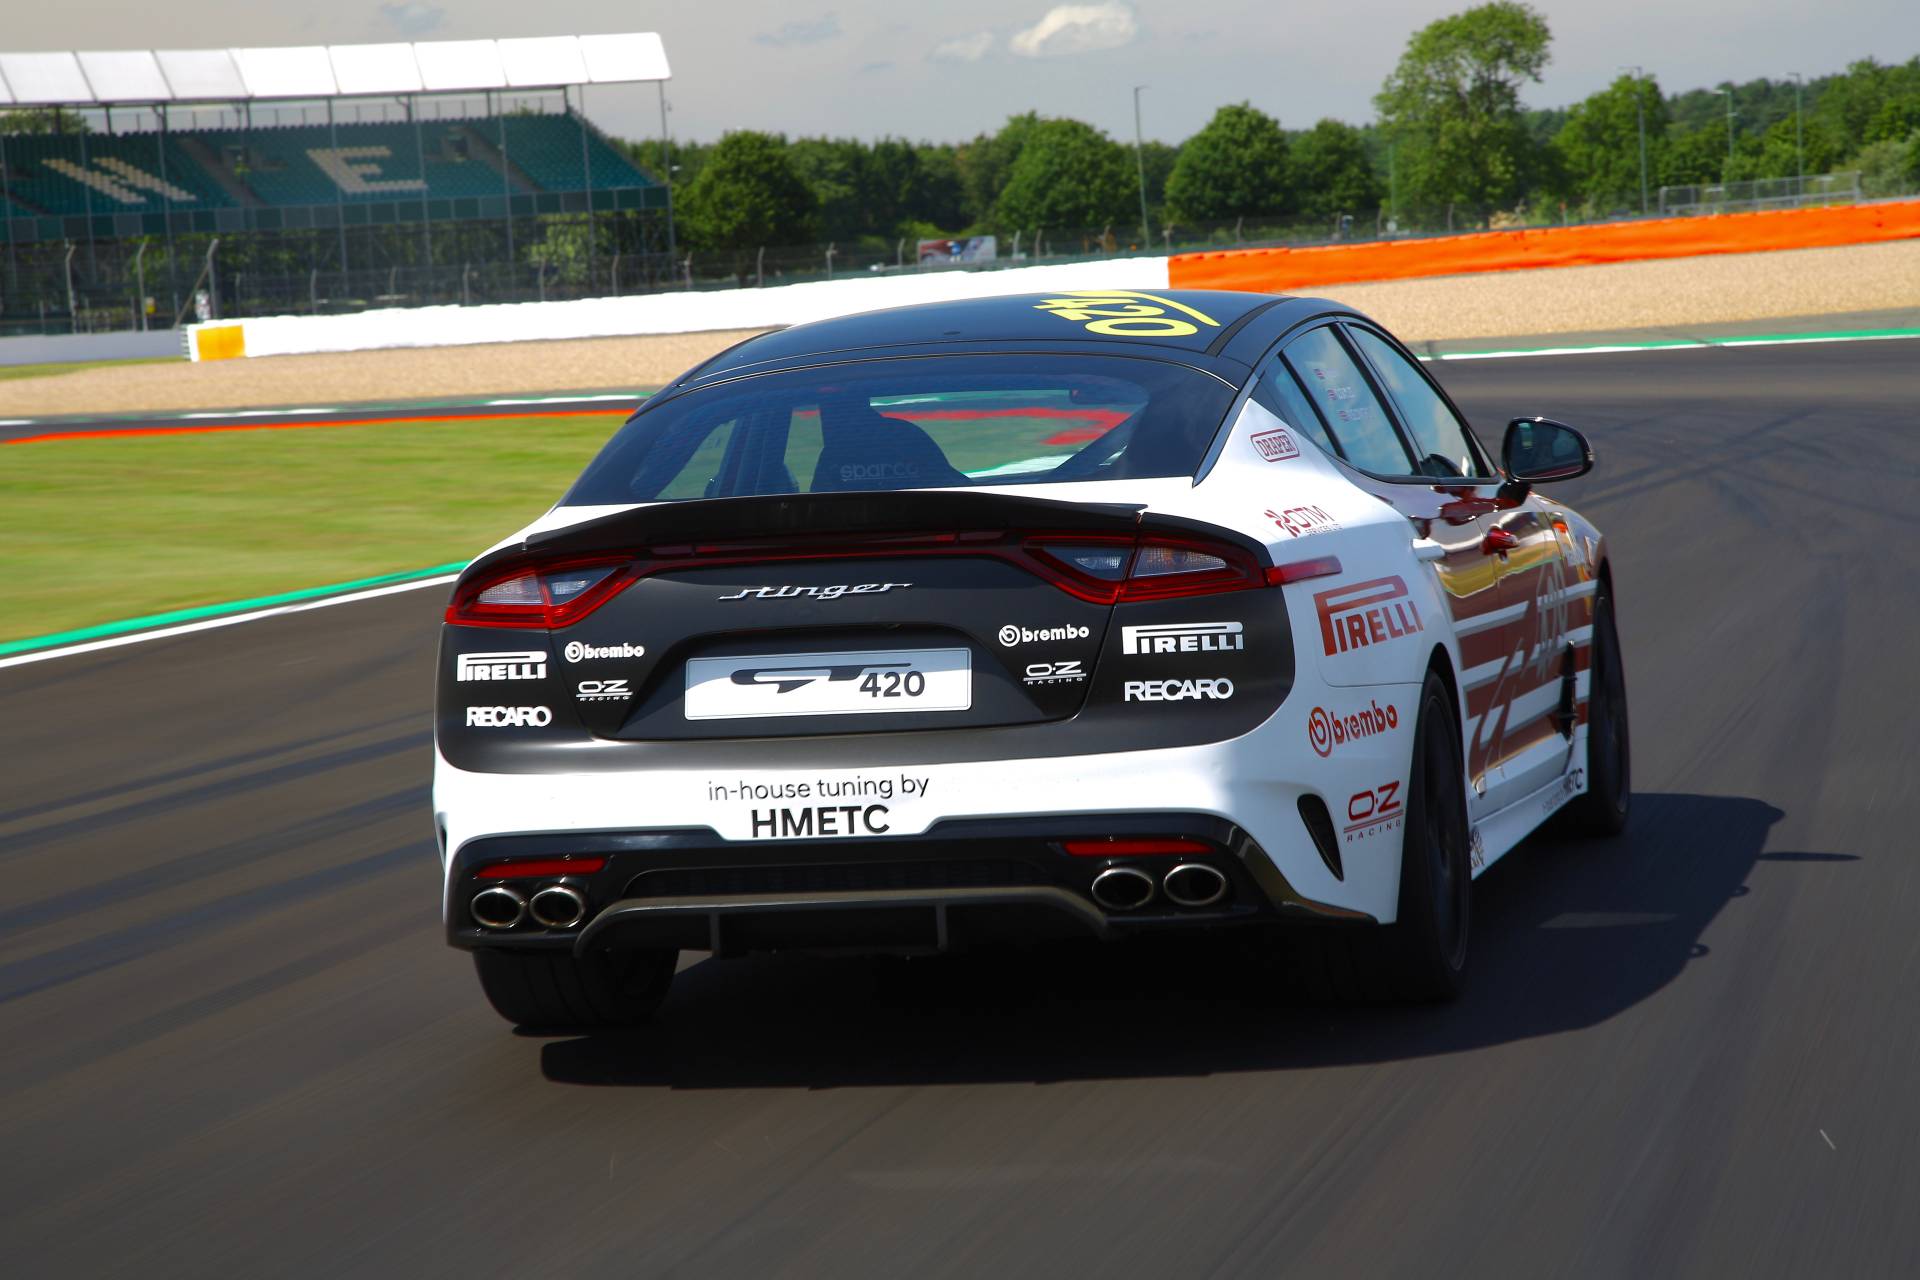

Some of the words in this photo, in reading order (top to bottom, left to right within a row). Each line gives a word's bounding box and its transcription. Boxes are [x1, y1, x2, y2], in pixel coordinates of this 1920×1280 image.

[1032, 298, 1198, 337] 420
[1256, 434, 1297, 457] DRAPER
[840, 463, 920, 481] sparco
[1313, 574, 1424, 656] PIRELLI
[1022, 623, 1090, 644] brembo
[1122, 622, 1244, 655] PIRELLI
[584, 643, 645, 660] brembo
[456, 650, 547, 682] PIRELLI
[859, 670, 926, 698] 420
[1027, 677, 1083, 686] RACING
[1124, 677, 1234, 702] RECARO
[466, 705, 552, 727] RECARO
[1330, 700, 1398, 745] brembo
[708, 780, 811, 801] in-house
[816, 775, 894, 799] tuning
[900, 773, 930, 798] by
[751, 803, 890, 838] HMETC
[1346, 819, 1402, 843] RACING
